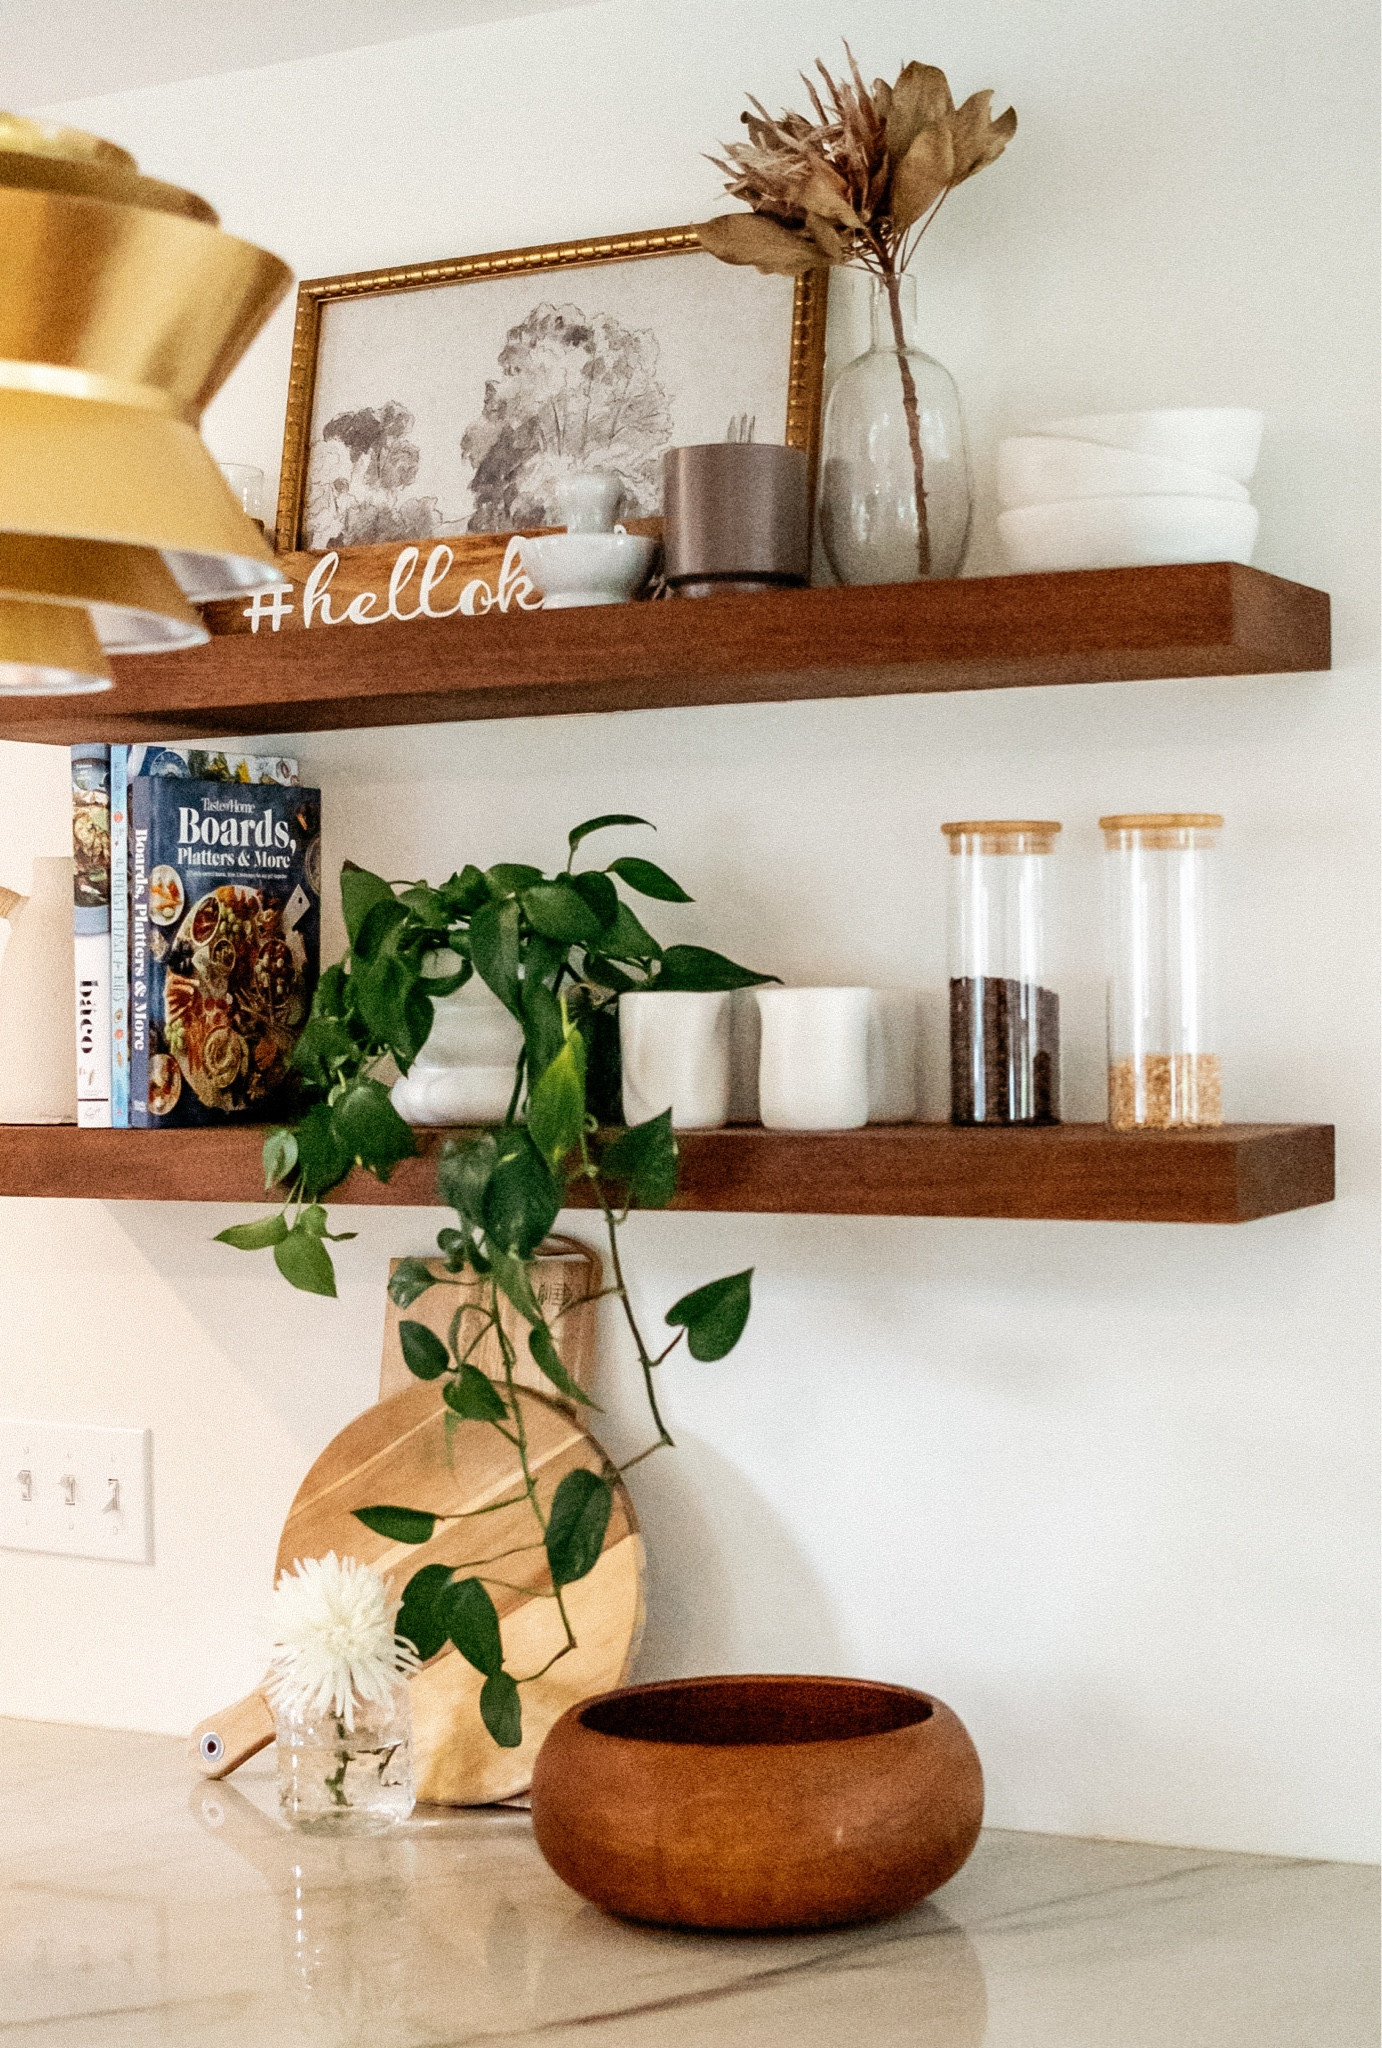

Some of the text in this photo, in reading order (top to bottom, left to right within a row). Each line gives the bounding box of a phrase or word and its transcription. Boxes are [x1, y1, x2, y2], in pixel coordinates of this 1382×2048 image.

[243, 535, 546, 634] #hellok
[177, 846, 291, 869] Platters & More
[178, 807, 297, 856] Boards,
[134, 829, 149, 1051] Boards, Platters & More
